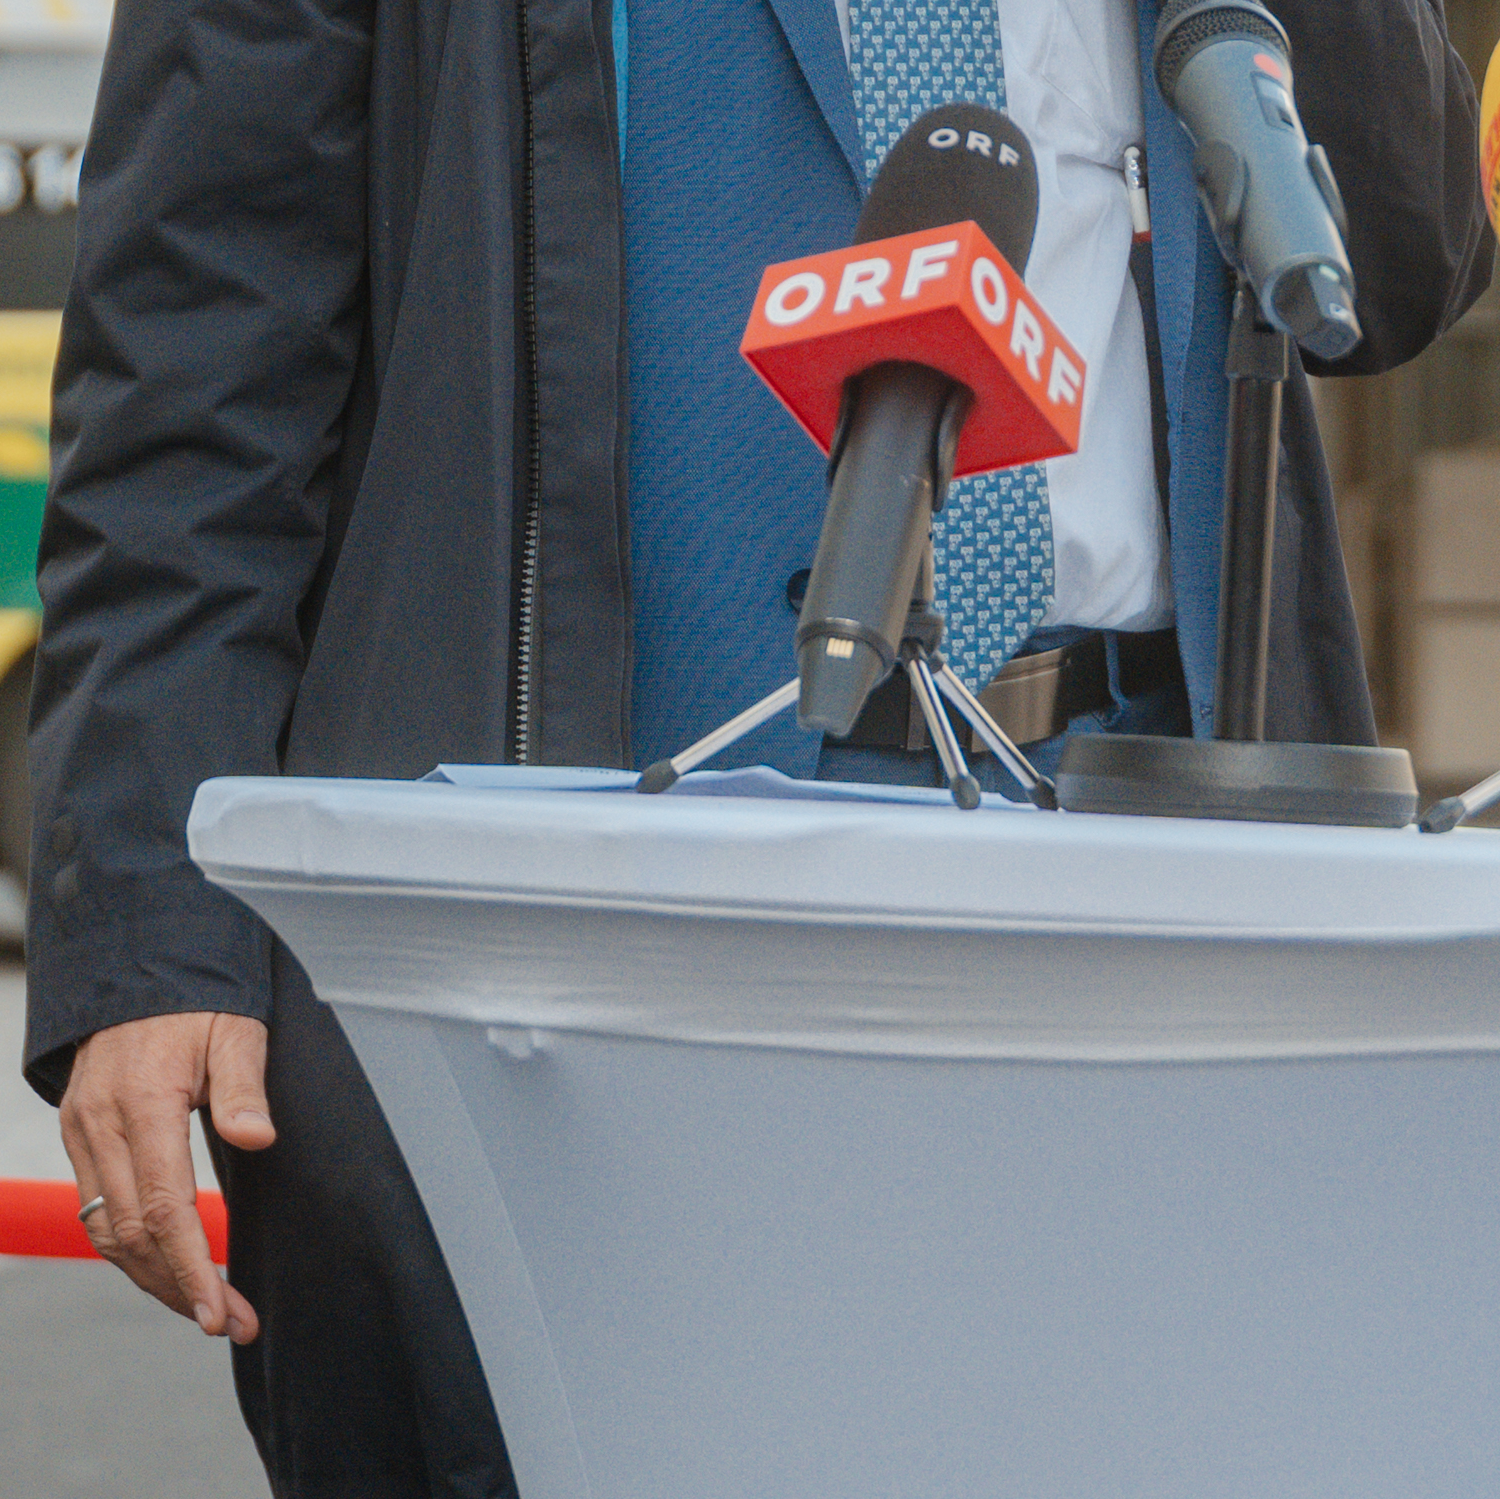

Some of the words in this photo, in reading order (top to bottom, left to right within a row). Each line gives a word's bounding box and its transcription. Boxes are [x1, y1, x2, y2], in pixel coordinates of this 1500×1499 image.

[927, 126, 1021, 167] ORF
[764, 239, 960, 328] ORF
[970, 256, 1082, 406] ORF
